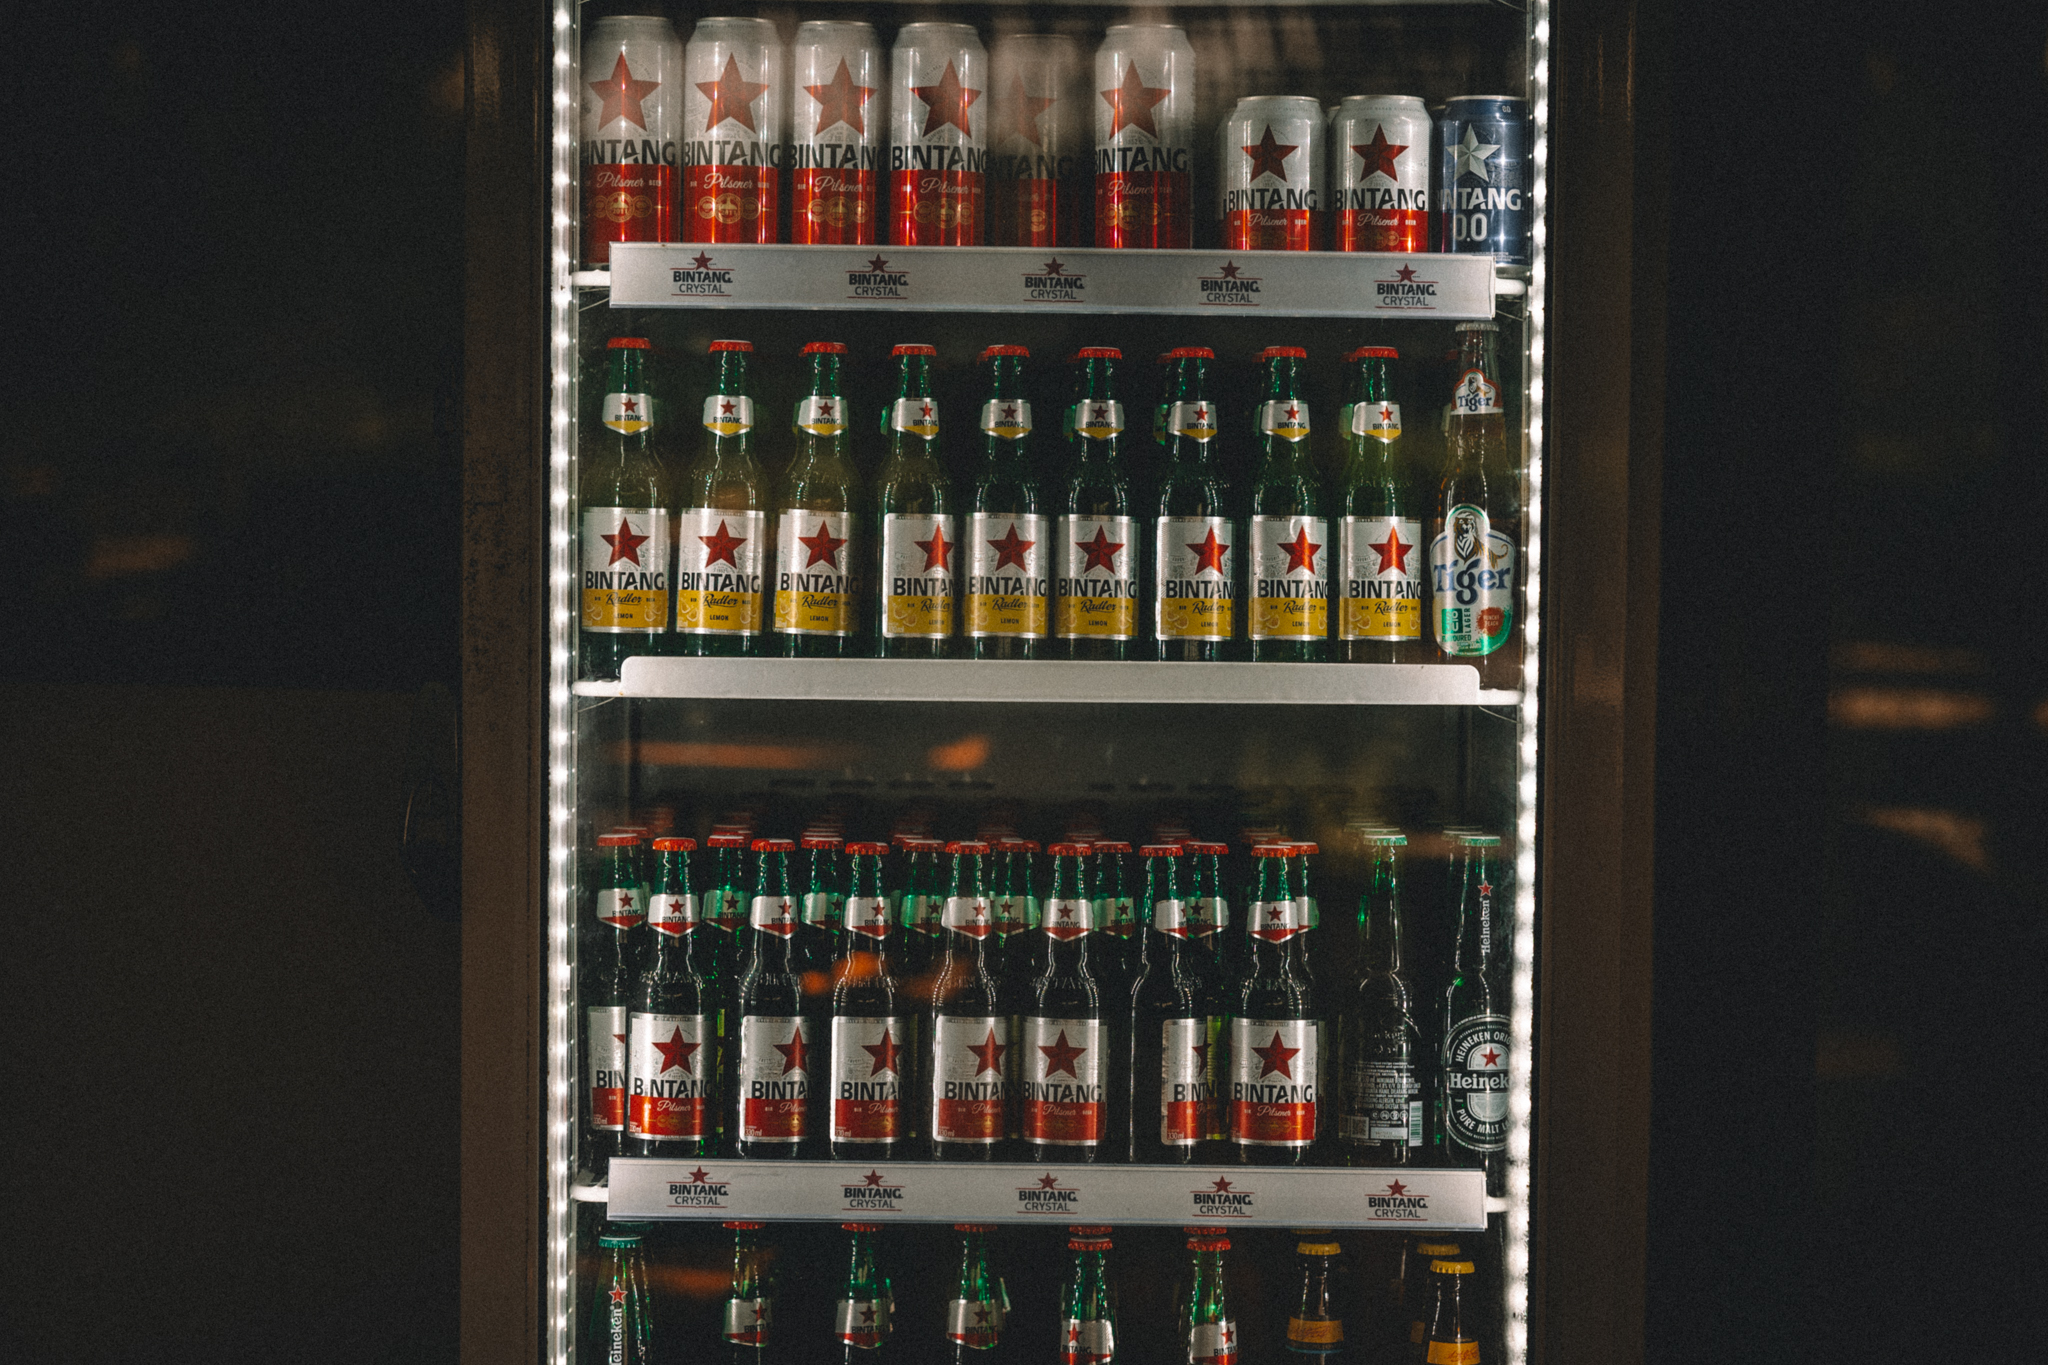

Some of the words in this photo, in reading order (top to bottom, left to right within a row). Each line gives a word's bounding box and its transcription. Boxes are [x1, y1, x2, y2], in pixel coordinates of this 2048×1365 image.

[788, 143, 880, 171] BINTAN
[597, 171, 644, 188] Pilsener
[703, 172, 753, 190] Pilsener
[813, 175, 863, 193] Pilsener
[920, 177, 969, 194] Pilsener
[1229, 188, 1317, 212] BINTANG
[1335, 188, 1426, 211] BINTANG
[1248, 213, 1287, 227] Pilsener
[1357, 213, 1399, 227] Pilsener
[673, 271, 733, 283] BINTANG
[849, 274, 909, 286] BINTANG
[1025, 276, 1085, 289] BINTANG
[679, 284, 724, 294] CRYSTAL
[855, 286, 900, 296] CRYSTAL
[1201, 280, 1261, 292] BINTANG
[1377, 283, 1437, 296] BINTANG
[1031, 289, 1076, 299] CRYSTAL
[1207, 292, 1253, 303] CRYSTAL
[1383, 296, 1429, 306] CRYSTAL
[1458, 393, 1492, 412] Tiger
[585, 571, 666, 591] BINTANG
[681, 572, 761, 594] BINTANG
[1434, 558, 1511, 606] Tiger
[1059, 579, 1137, 599] BINTANG
[606, 592, 642, 606] Radler
[703, 593, 739, 608] Radler
[802, 594, 838, 609] Radler
[992, 597, 1027, 612] Radler
[1080, 600, 1116, 614] Radler
[1481, 899, 1491, 954] Heineken
[1455, 1031, 1491, 1063] HEINEKEN
[1023, 1081, 1102, 1103] BINTANG
[1234, 1082, 1313, 1104] BINTANG
[657, 1100, 692, 1112] Pilsener
[1043, 1104, 1076, 1116] Pilsener
[1257, 1105, 1291, 1117] Pilsener
[1457, 1108, 1477, 1131] PURE
[1477, 1122, 1500, 1134] MALT
[669, 1184, 729, 1196] BINTANG
[844, 1187, 904, 1199] BINTANG
[1018, 1190, 1079, 1202] BINTANG
[675, 1196, 720, 1205] CRYSTAL
[850, 1199, 896, 1208] CRYSTAL
[1193, 1193, 1254, 1205] BINTANG
[1368, 1197, 1428, 1208] BINTANG
[1025, 1202, 1071, 1212] CRYSTAL
[1199, 1205, 1246, 1215] CRYSTAL
[1375, 1208, 1421, 1218] CRYSTAL
[611, 1308, 623, 1365] eineken
